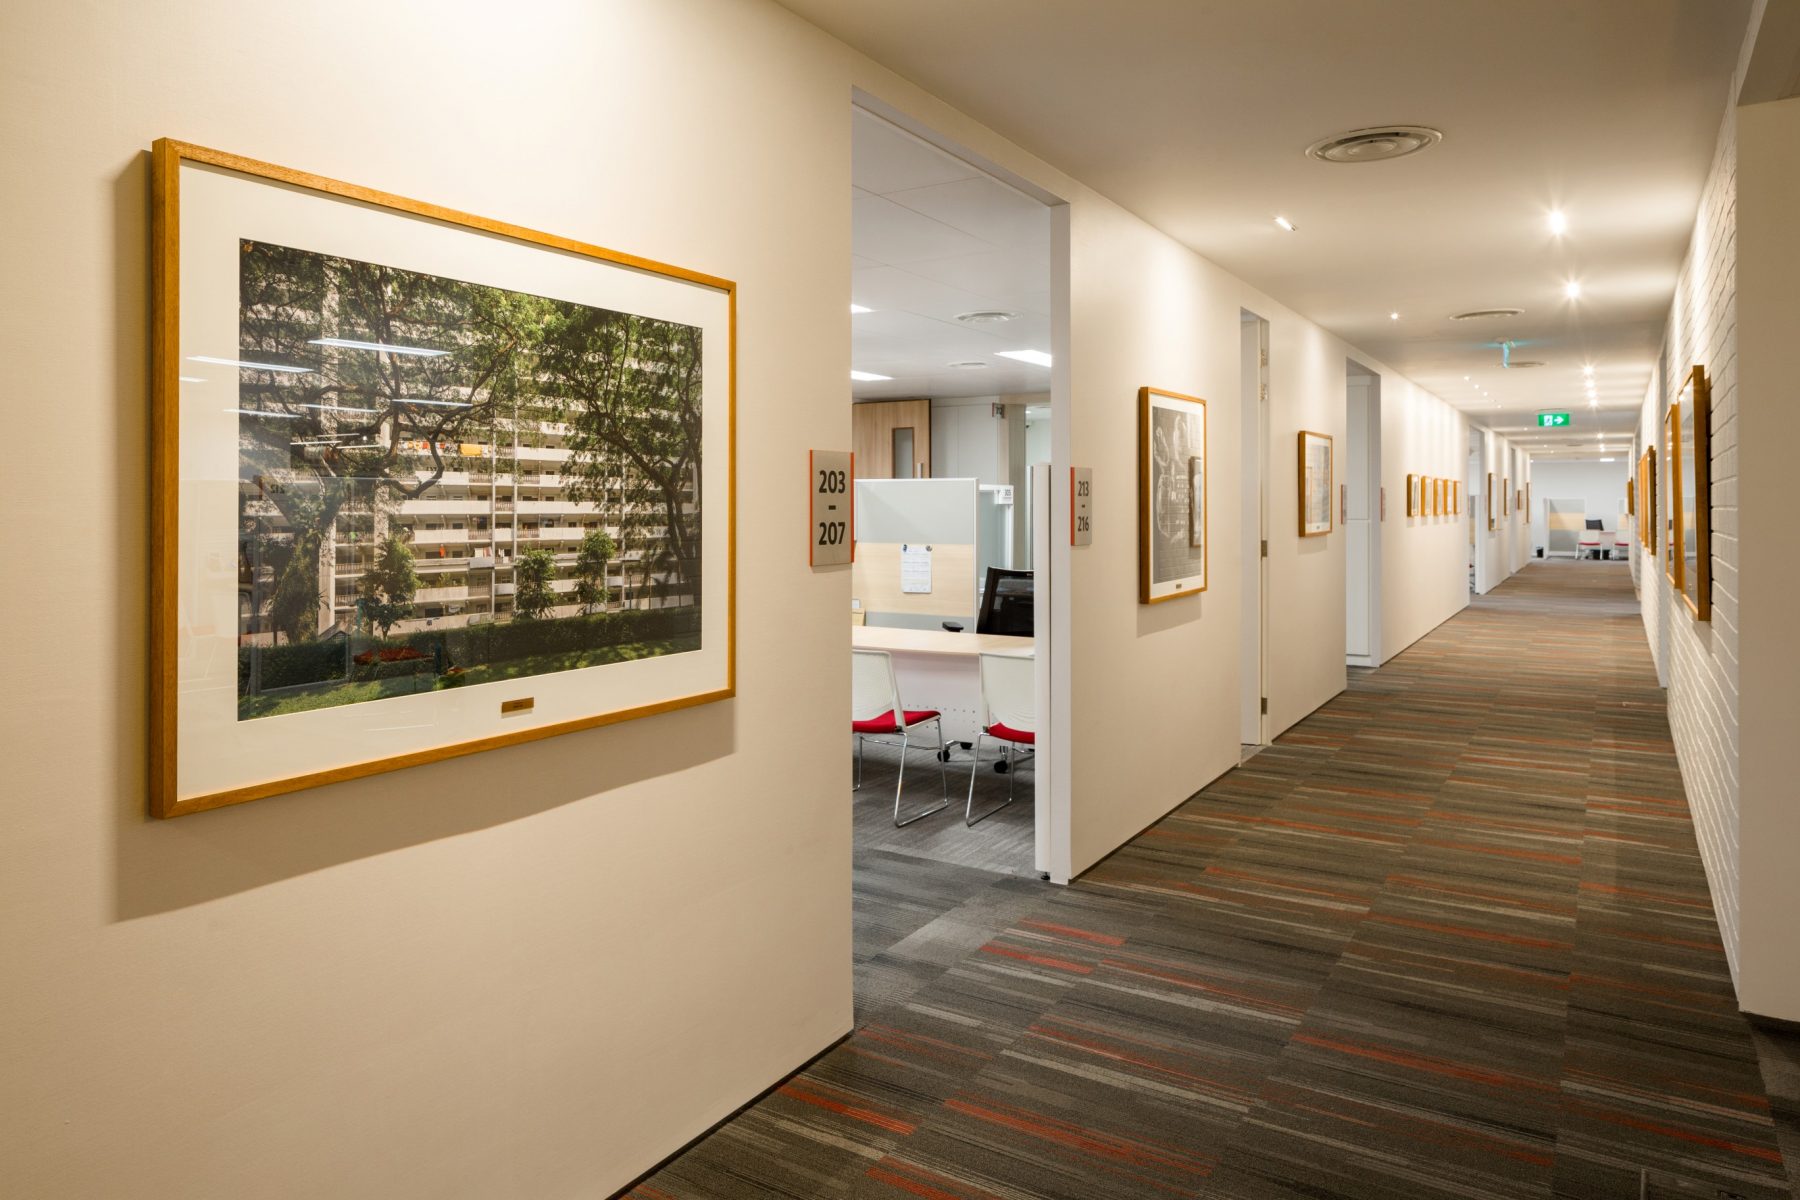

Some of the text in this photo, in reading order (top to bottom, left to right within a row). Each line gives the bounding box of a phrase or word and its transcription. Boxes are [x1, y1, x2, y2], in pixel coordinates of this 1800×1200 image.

[819, 470, 846, 494] 203
[1078, 481, 1089, 496] 213
[1078, 516, 1089, 531] 216
[819, 522, 846, 545] 207
